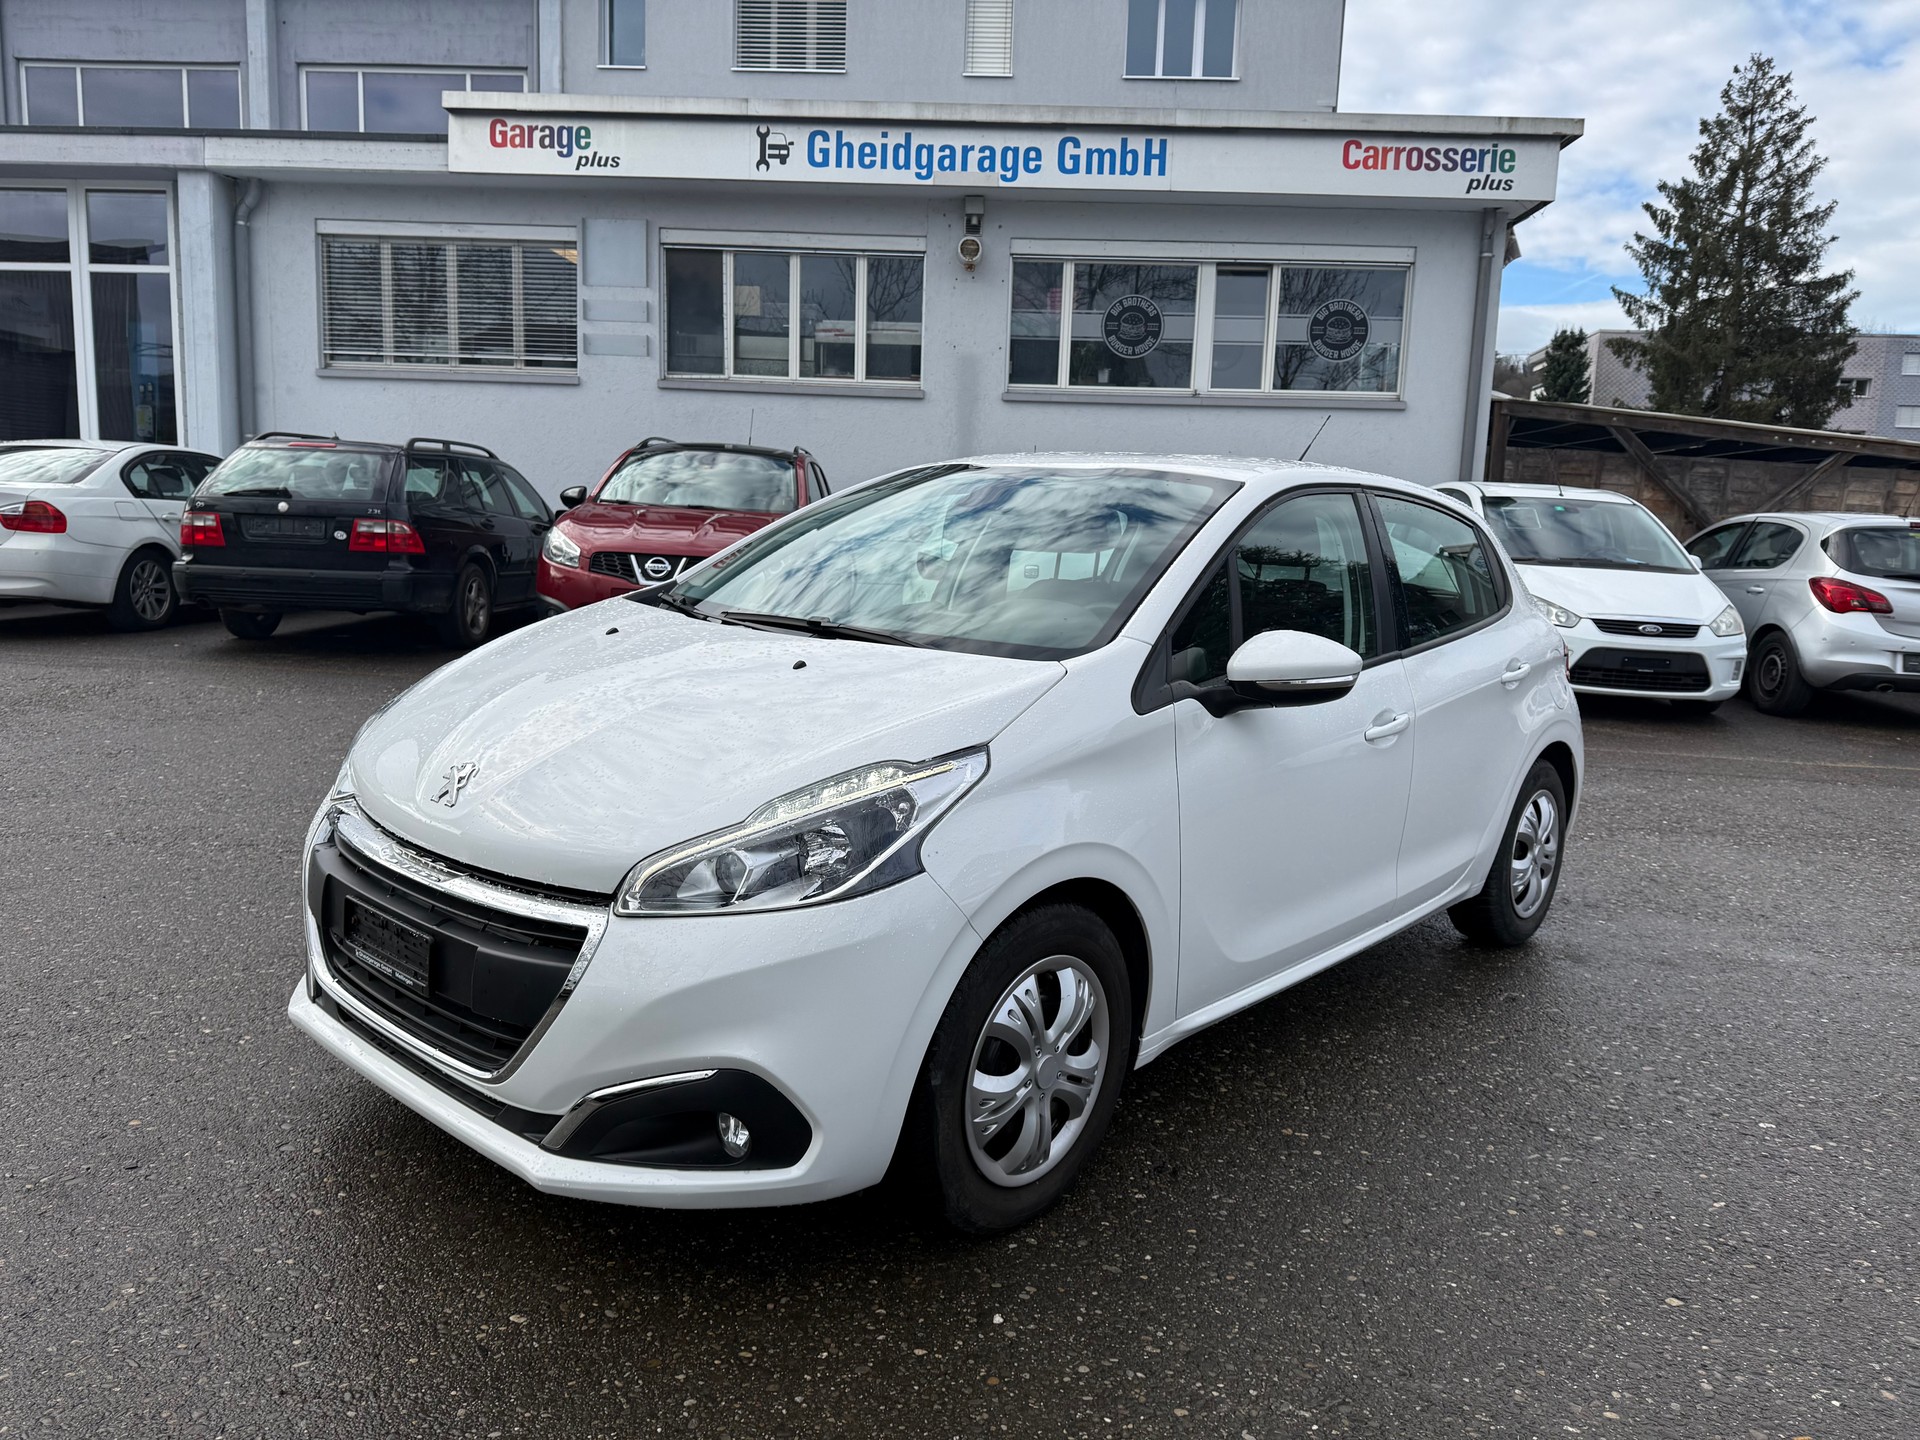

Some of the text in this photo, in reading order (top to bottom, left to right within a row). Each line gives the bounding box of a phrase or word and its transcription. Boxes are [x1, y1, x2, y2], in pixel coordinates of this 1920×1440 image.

[489, 118, 591, 158] Garage
[576, 151, 621, 170] plus
[807, 129, 1168, 184] Gheidgarage GmbH
[1342, 139, 1516, 173] Carrosserie
[1466, 173, 1514, 194] plus
[1110, 297, 1158, 317] BIG BROTHERS
[1316, 301, 1365, 321] BIG BROTHERS
[1107, 334, 1157, 355] BURGER HOUSE
[1313, 338, 1363, 359] BURGER HOUSE
